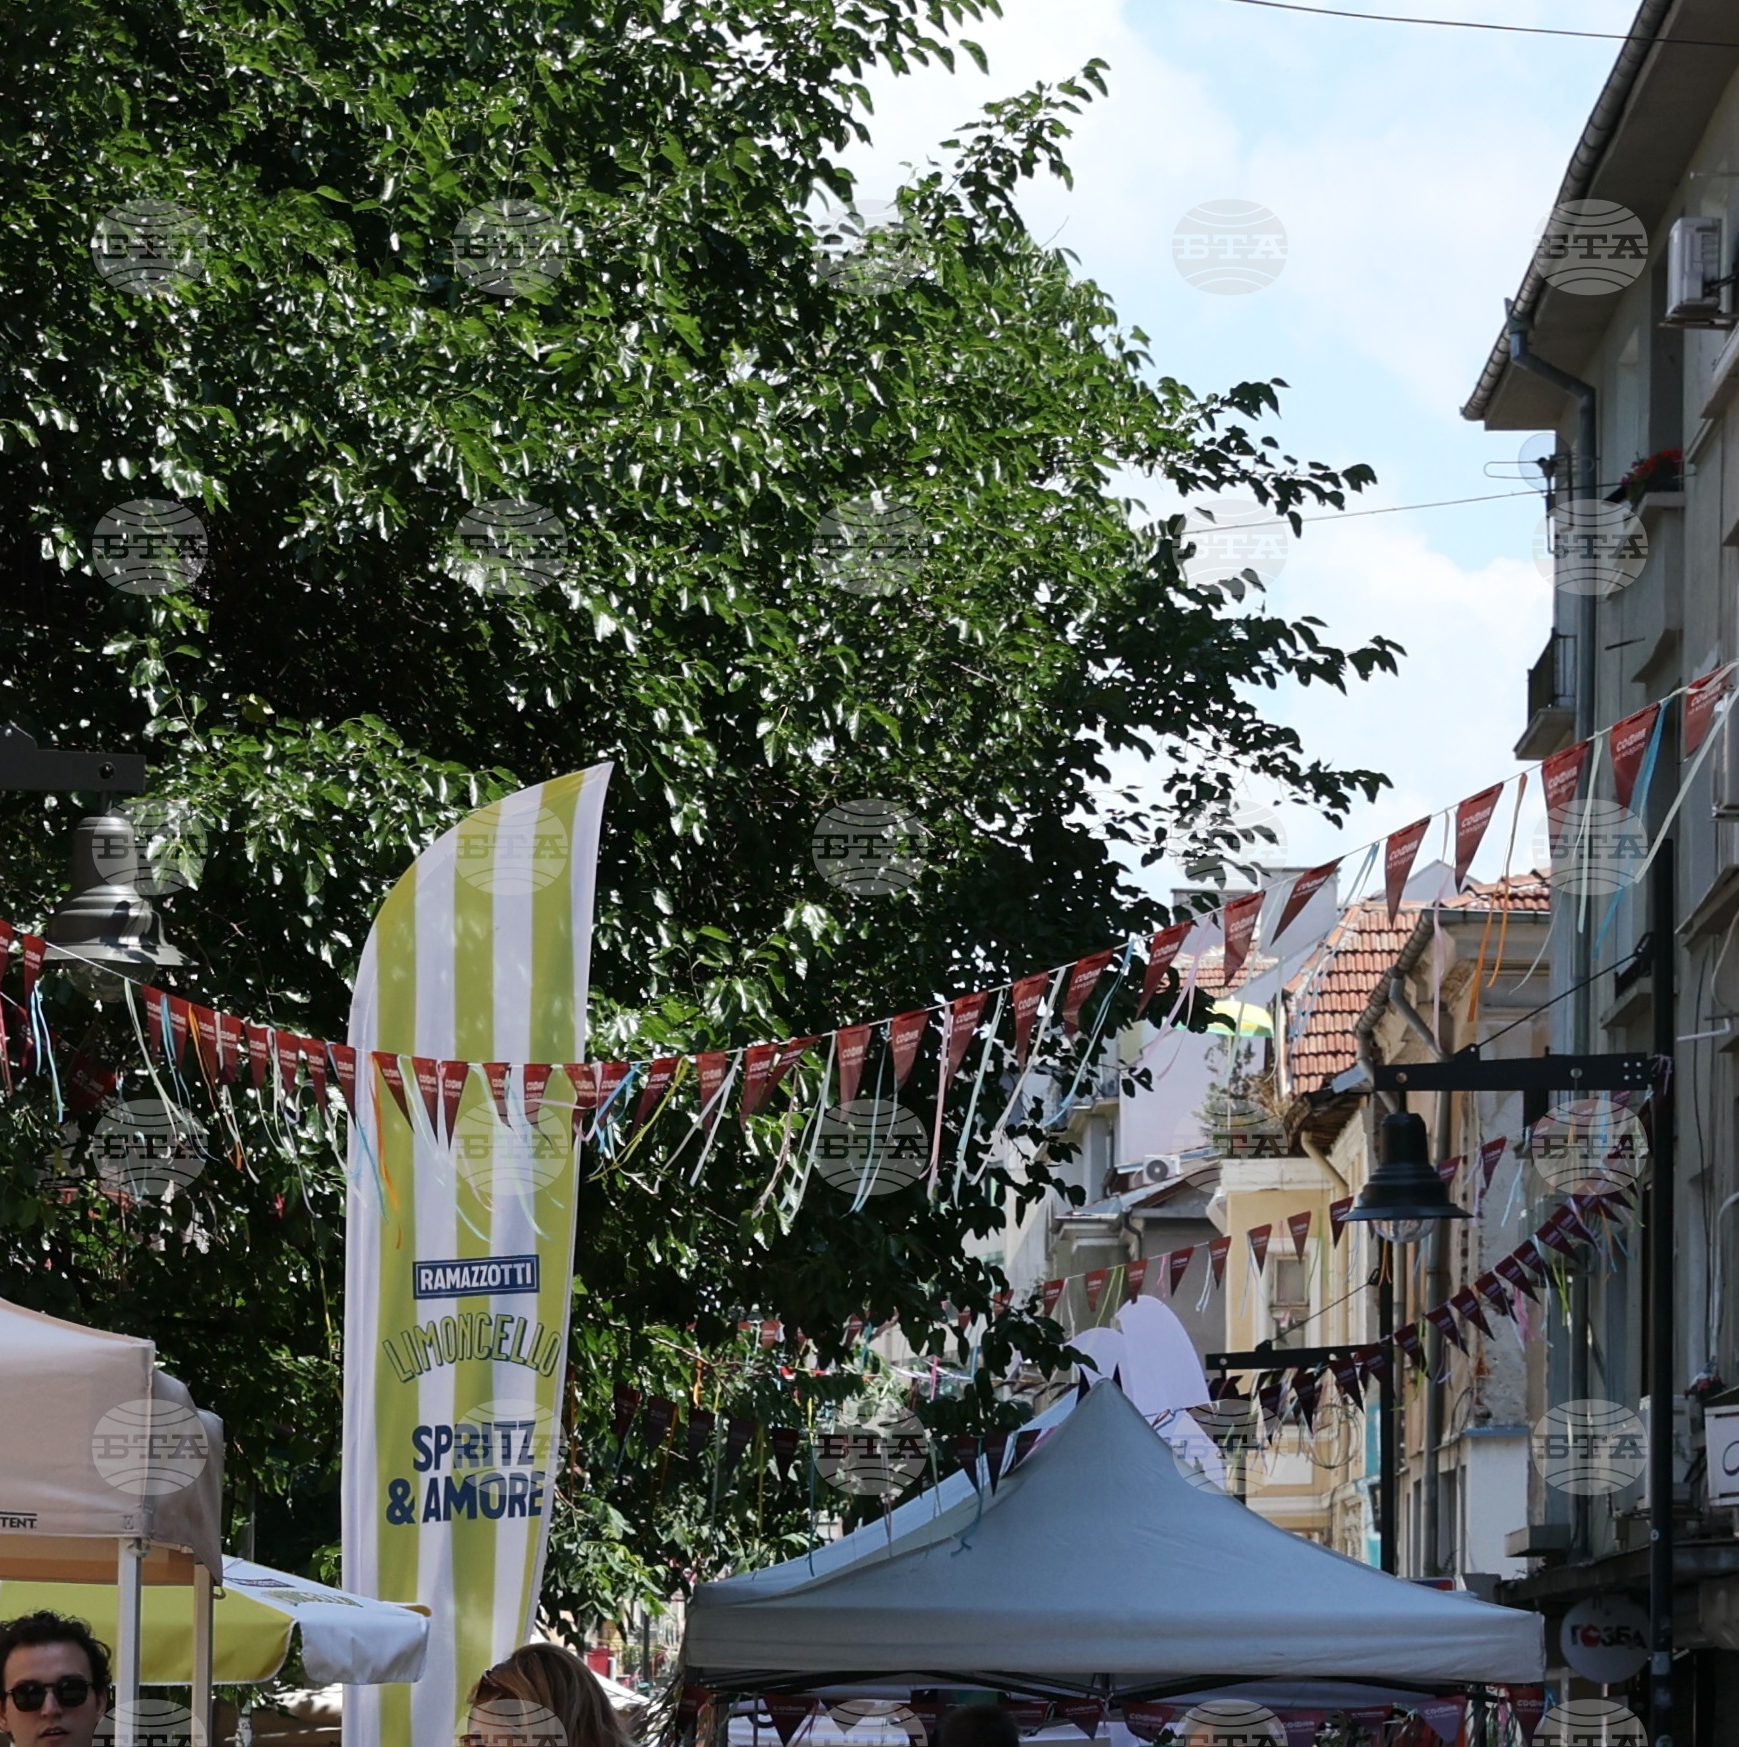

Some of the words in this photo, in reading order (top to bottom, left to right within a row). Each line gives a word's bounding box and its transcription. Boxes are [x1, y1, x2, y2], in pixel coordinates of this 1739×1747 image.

[420, 1262, 533, 1290] RAMAZZOTTI
[382, 1312, 563, 1384] LIMONCELLO
[412, 1421, 537, 1473] SPRITZ
[386, 1478, 416, 1525] &
[422, 1471, 546, 1523] AMORE
